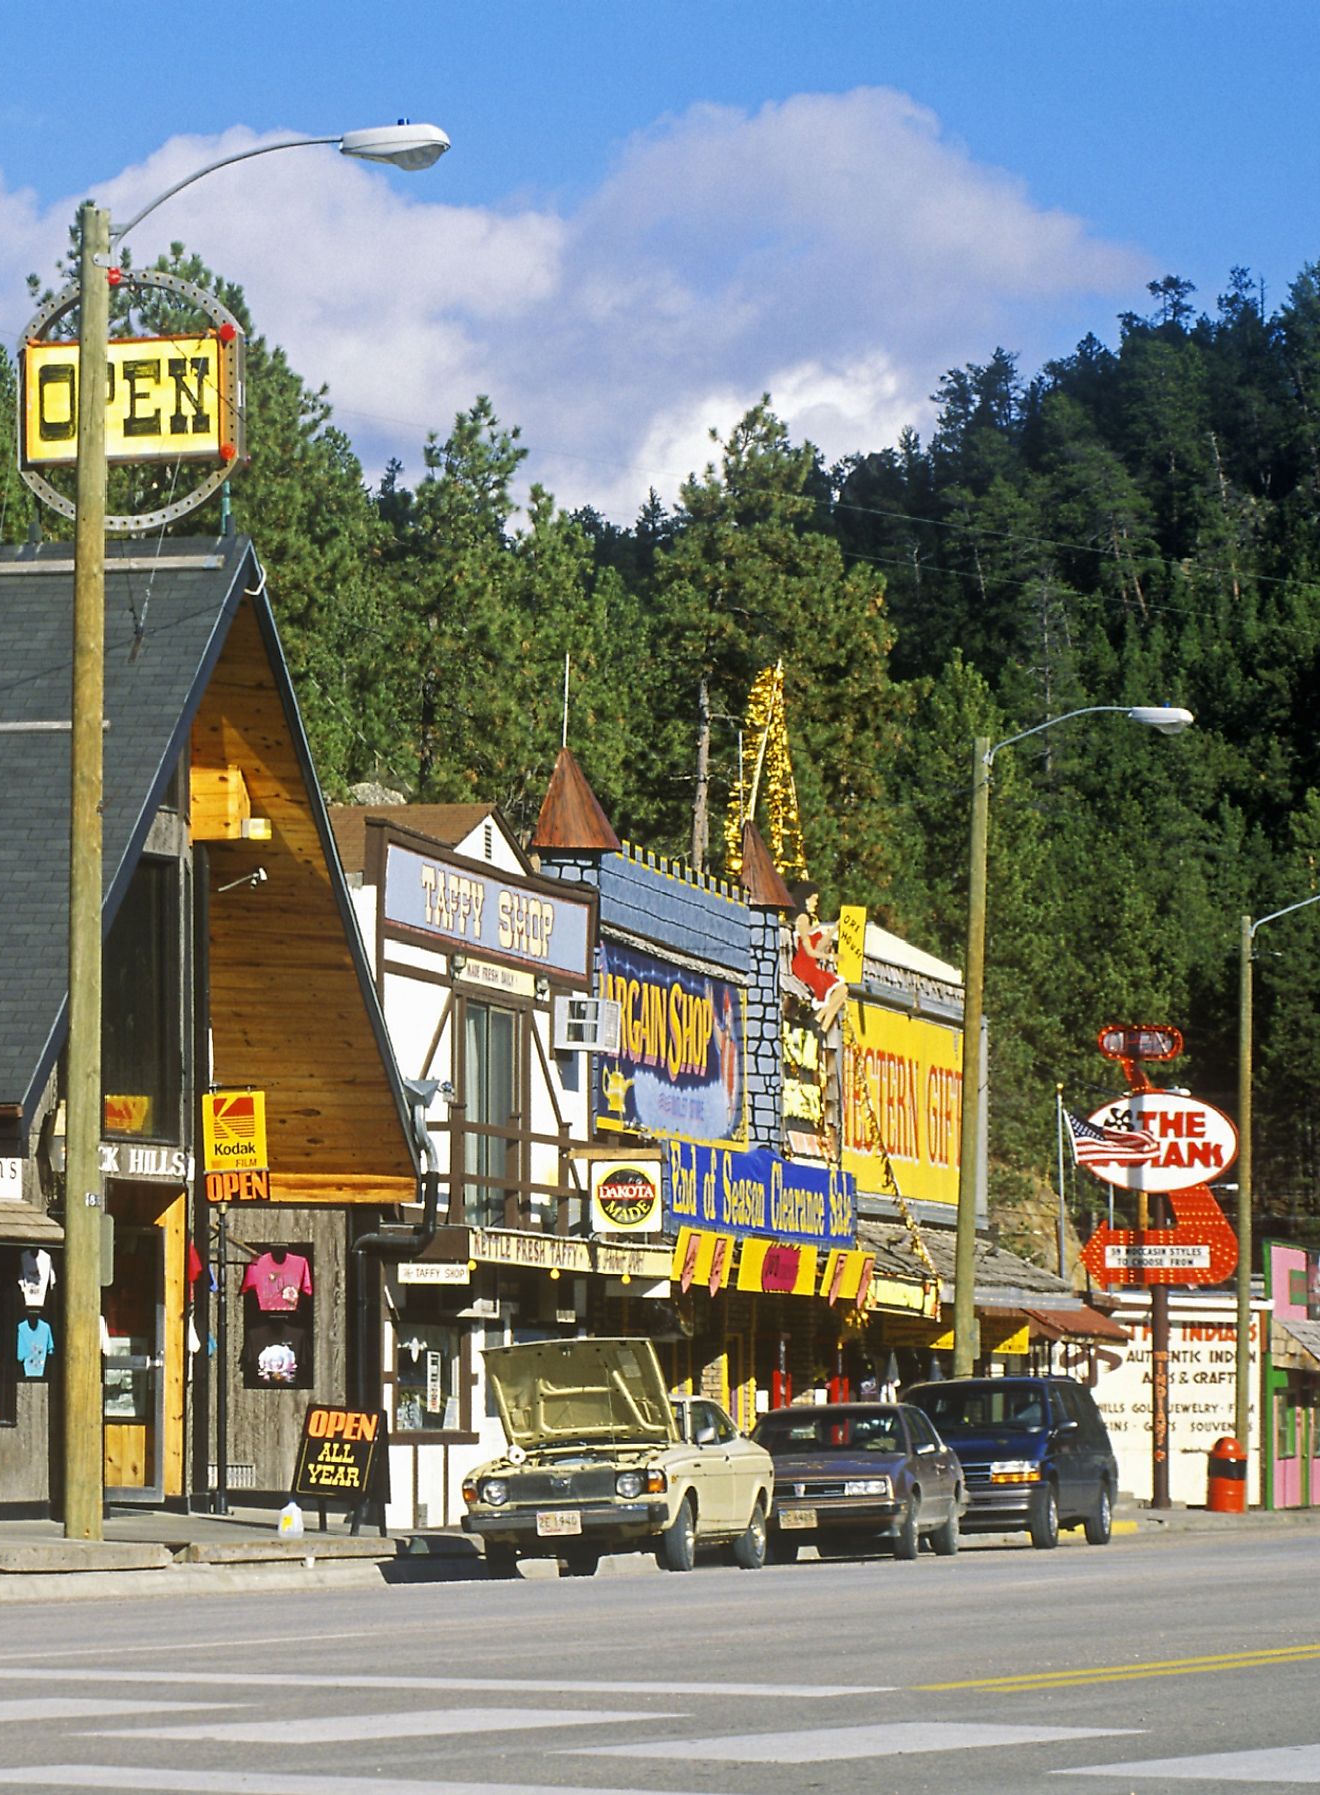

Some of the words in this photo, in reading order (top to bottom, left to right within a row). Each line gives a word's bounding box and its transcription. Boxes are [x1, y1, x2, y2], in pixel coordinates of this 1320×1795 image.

[421, 864, 485, 939] TAFFY
[497, 890, 554, 958] SHOP
[667, 982, 714, 1081] SHOP
[1137, 1110, 1206, 1138] THE
[129, 1148, 187, 1177] HILLS
[214, 1141, 256, 1156] Kodak
[235, 1158, 257, 1168] FILM
[206, 1171, 268, 1202] OPEN
[599, 1185, 654, 1199] DAKOTA
[670, 1140, 697, 1216] End
[703, 1148, 717, 1221] of
[723, 1150, 765, 1228] Season
[771, 1161, 825, 1236] Clearance
[830, 1168, 852, 1238] Sale
[605, 1200, 650, 1222] MADE
[516, 1236, 545, 1264] FRESH
[549, 1240, 579, 1268] TAFFY
[1169, 1248, 1202, 1256] STYLES
[307, 1409, 378, 1442] OPEN
[318, 1443, 355, 1464] ALL
[307, 1464, 361, 1488] YEAR
